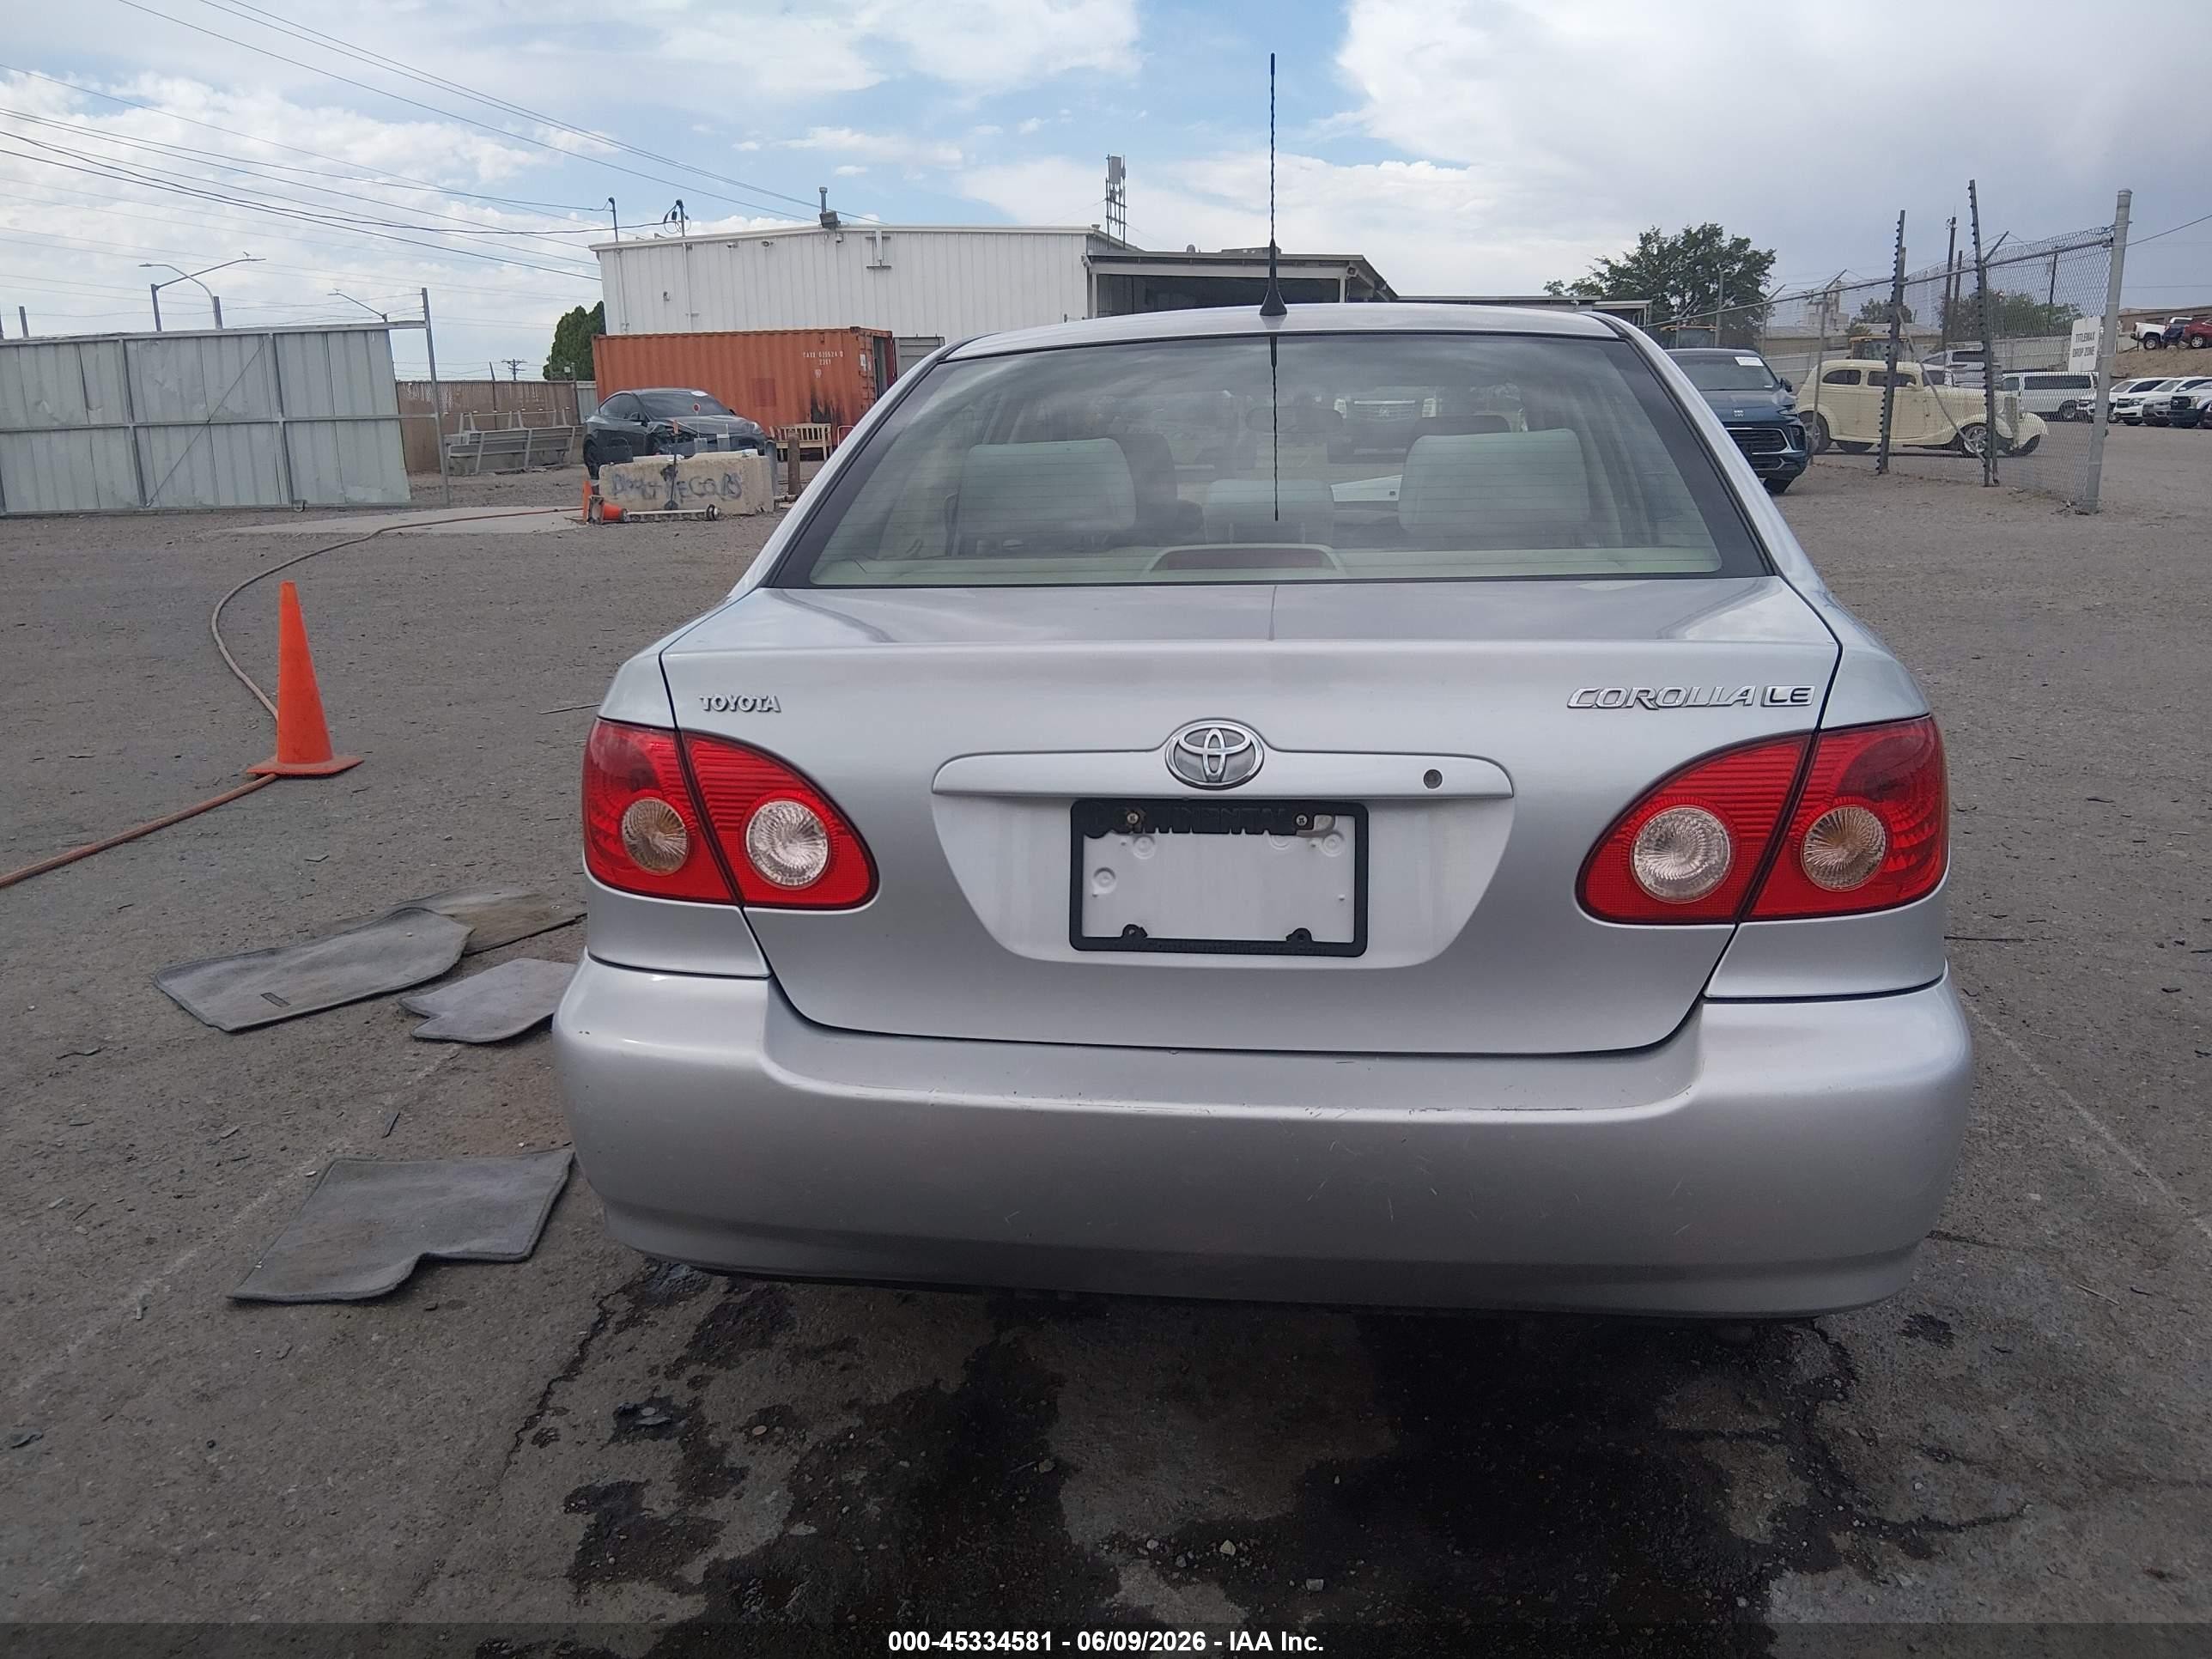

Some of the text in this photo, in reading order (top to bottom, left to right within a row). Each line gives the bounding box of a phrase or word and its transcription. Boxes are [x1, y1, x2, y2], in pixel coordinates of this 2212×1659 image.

[2075, 331, 2096, 343] TITLEMAX
[2072, 346, 2095, 358] DROP ZONE
[699, 694, 781, 713] TOYOTA
[1567, 686, 1814, 709] COROLLA LE
